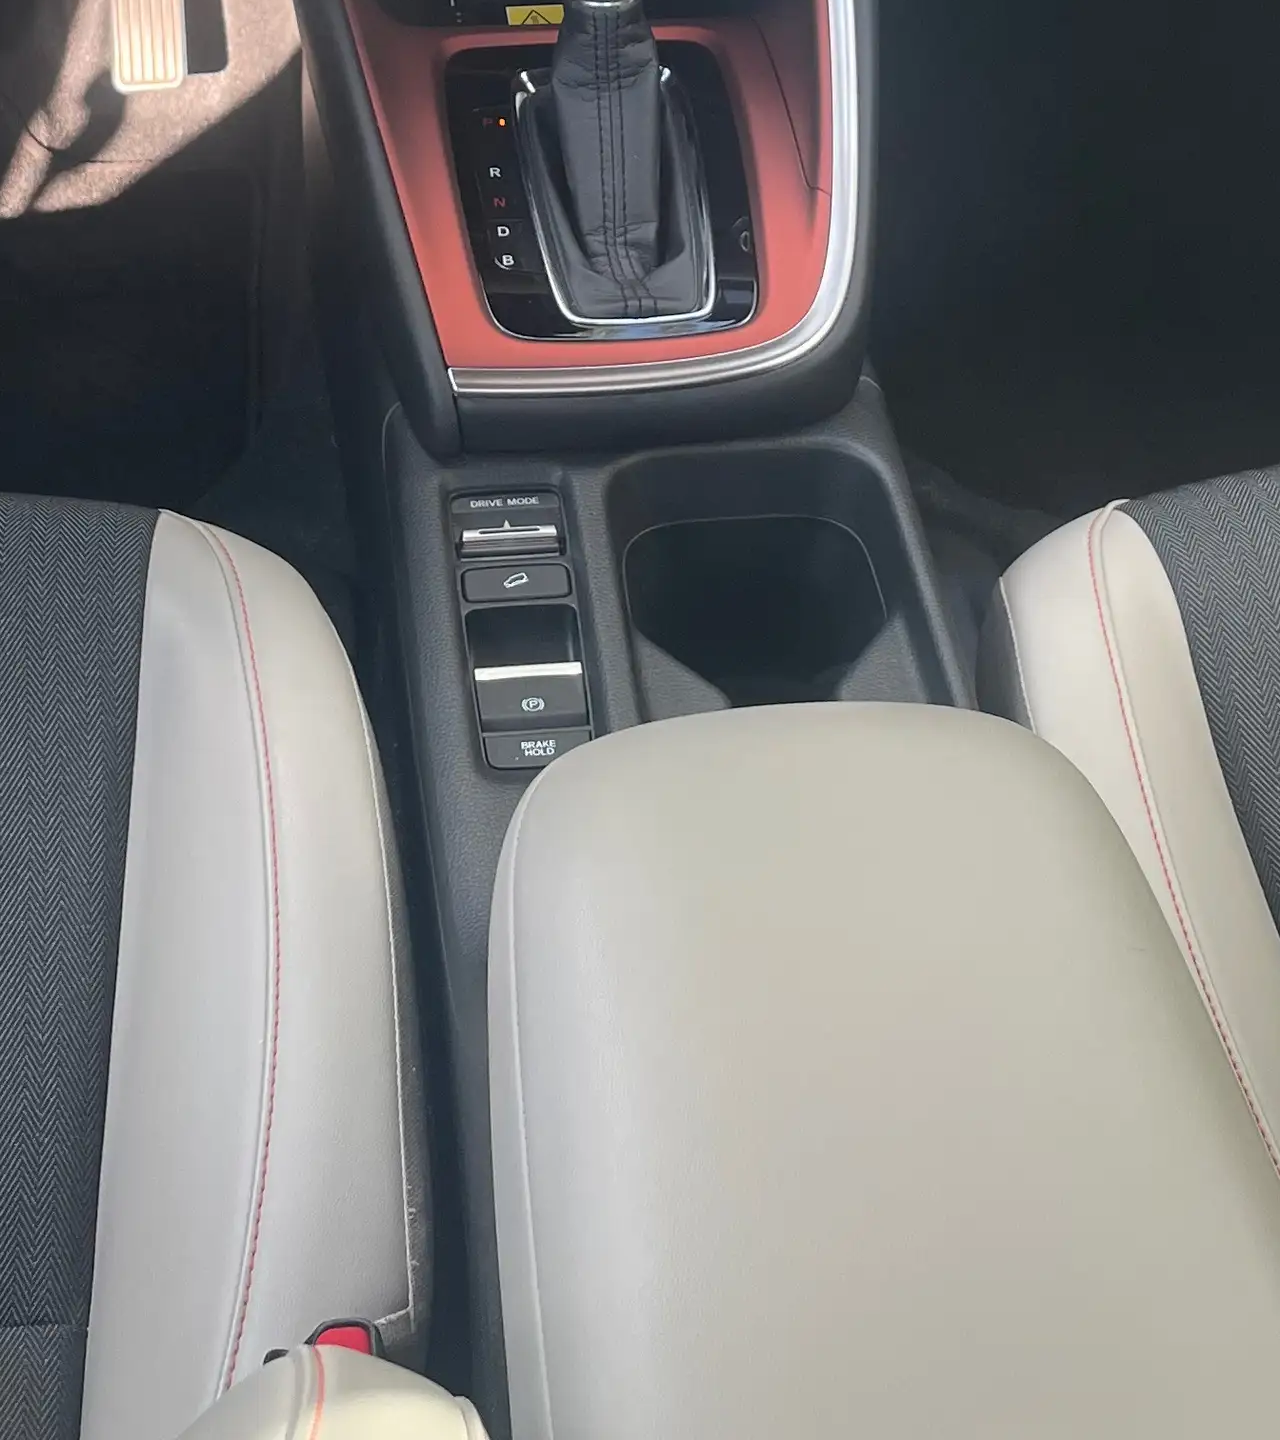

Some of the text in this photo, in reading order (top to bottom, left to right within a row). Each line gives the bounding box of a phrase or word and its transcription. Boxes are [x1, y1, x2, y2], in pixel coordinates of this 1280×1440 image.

[483, 117, 494, 127] P
[489, 167, 502, 178] R
[493, 197, 506, 208] N
[497, 226, 510, 237] D
[502, 255, 515, 266] B
[470, 496, 540, 508] DRIVE MODE
[521, 740, 556, 750] BRAKE
[524, 746, 555, 756] HOLD
